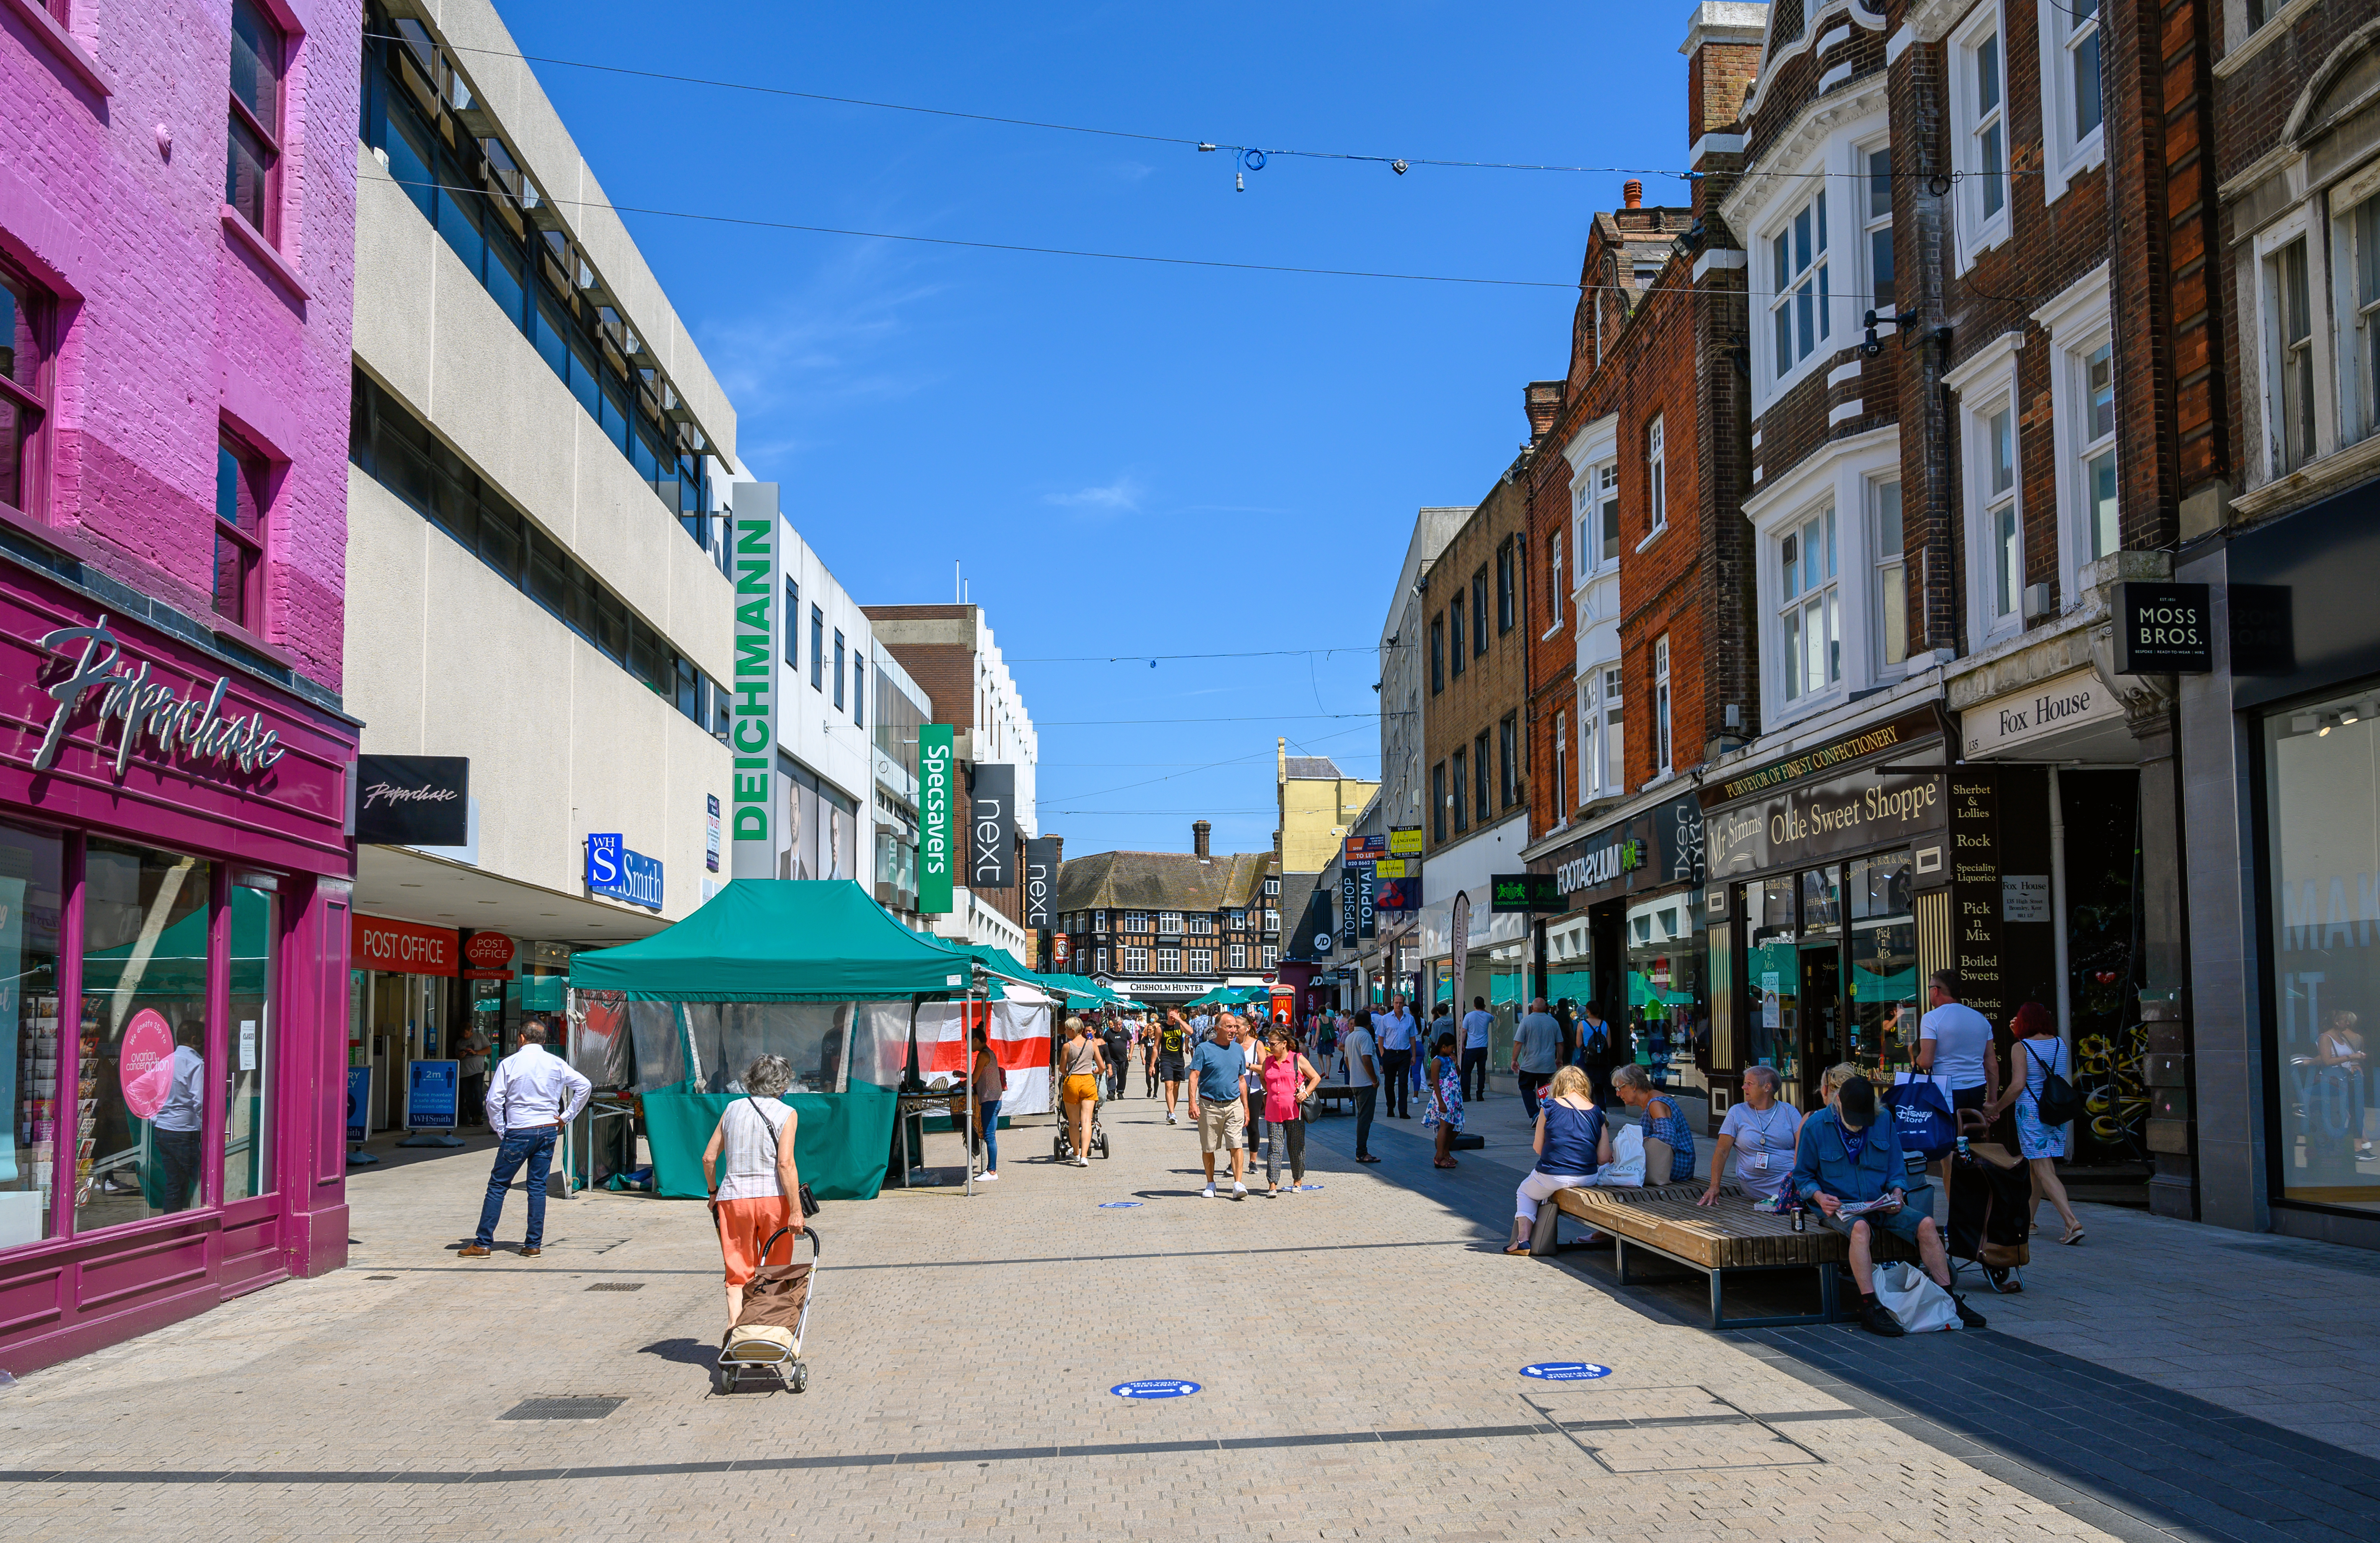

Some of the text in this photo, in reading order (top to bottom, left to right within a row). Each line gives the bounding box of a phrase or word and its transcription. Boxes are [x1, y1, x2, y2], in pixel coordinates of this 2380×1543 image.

[2139, 608, 2196, 624] MOSS
[2140, 628, 2203, 644] BROS.
[734, 520, 771, 840] DEICHMANN
[32, 614, 286, 776] Paperchase
[1999, 691, 2090, 736] Fox House
[1968, 739, 1979, 752] 135
[1725, 726, 1898, 798] PURVEYOR OF FINEST CONFECTIONERY
[365, 781, 458, 809] Paperchase
[1953, 784, 1991, 794] Sherbet
[1968, 796, 1978, 806] &
[922, 744, 949, 874] Specsavers
[1957, 808, 1989, 818] Lollies
[709, 815, 714, 827] TO
[1710, 825, 1726, 874] Mr
[1728, 815, 1762, 849] Simms
[1771, 808, 1808, 845] Olde
[1811, 799, 1860, 835] Sweet
[1865, 783, 1936, 821] Shoppe
[593, 837, 616, 847] WH
[976, 799, 1000, 882] next
[1956, 834, 1991, 847] Rock
[593, 847, 616, 882] S
[1557, 844, 1620, 895] FOOTASYLUM
[1845, 855, 1897, 880] Candy Canes, Rock &
[1957, 863, 1996, 873] Speciality
[597, 853, 661, 904] Smith
[1765, 879, 1780, 890] Boiled
[1957, 874, 1996, 883] Liquorice
[1029, 864, 1048, 925] next
[1361, 868, 1373, 928] TOPMA
[1344, 877, 1355, 937] TOPSHOP
[1963, 902, 1991, 914] Pick
[1973, 919, 1982, 928] n
[1876, 927, 1891, 940] Pick
[1966, 928, 1991, 941] Mix
[364, 929, 444, 964] POST OFFICE
[477, 939, 505, 948] POST
[1316, 937, 1329, 946] JD
[1763, 943, 1774, 953] Pick
[470, 949, 508, 959] OFFICE
[1877, 947, 1891, 959] Mix
[1764, 960, 1775, 970] Mix
[1960, 955, 1997, 967] Boiled
[1656, 967, 1667, 981] SALE
[1960, 969, 1999, 981] Sweets
[1309, 976, 1323, 986] JD
[1763, 976, 1778, 986] OPEN
[1961, 998, 2002, 1008] Diabetic
[129, 1033, 137, 1045] We
[137, 1019, 153, 1034] donate
[161, 1034, 167, 1044] to
[131, 1049, 156, 1063] ovarian
[1780, 1068, 1785, 1076] &
[1851, 1061, 1896, 1083] Toffee, Nougat
